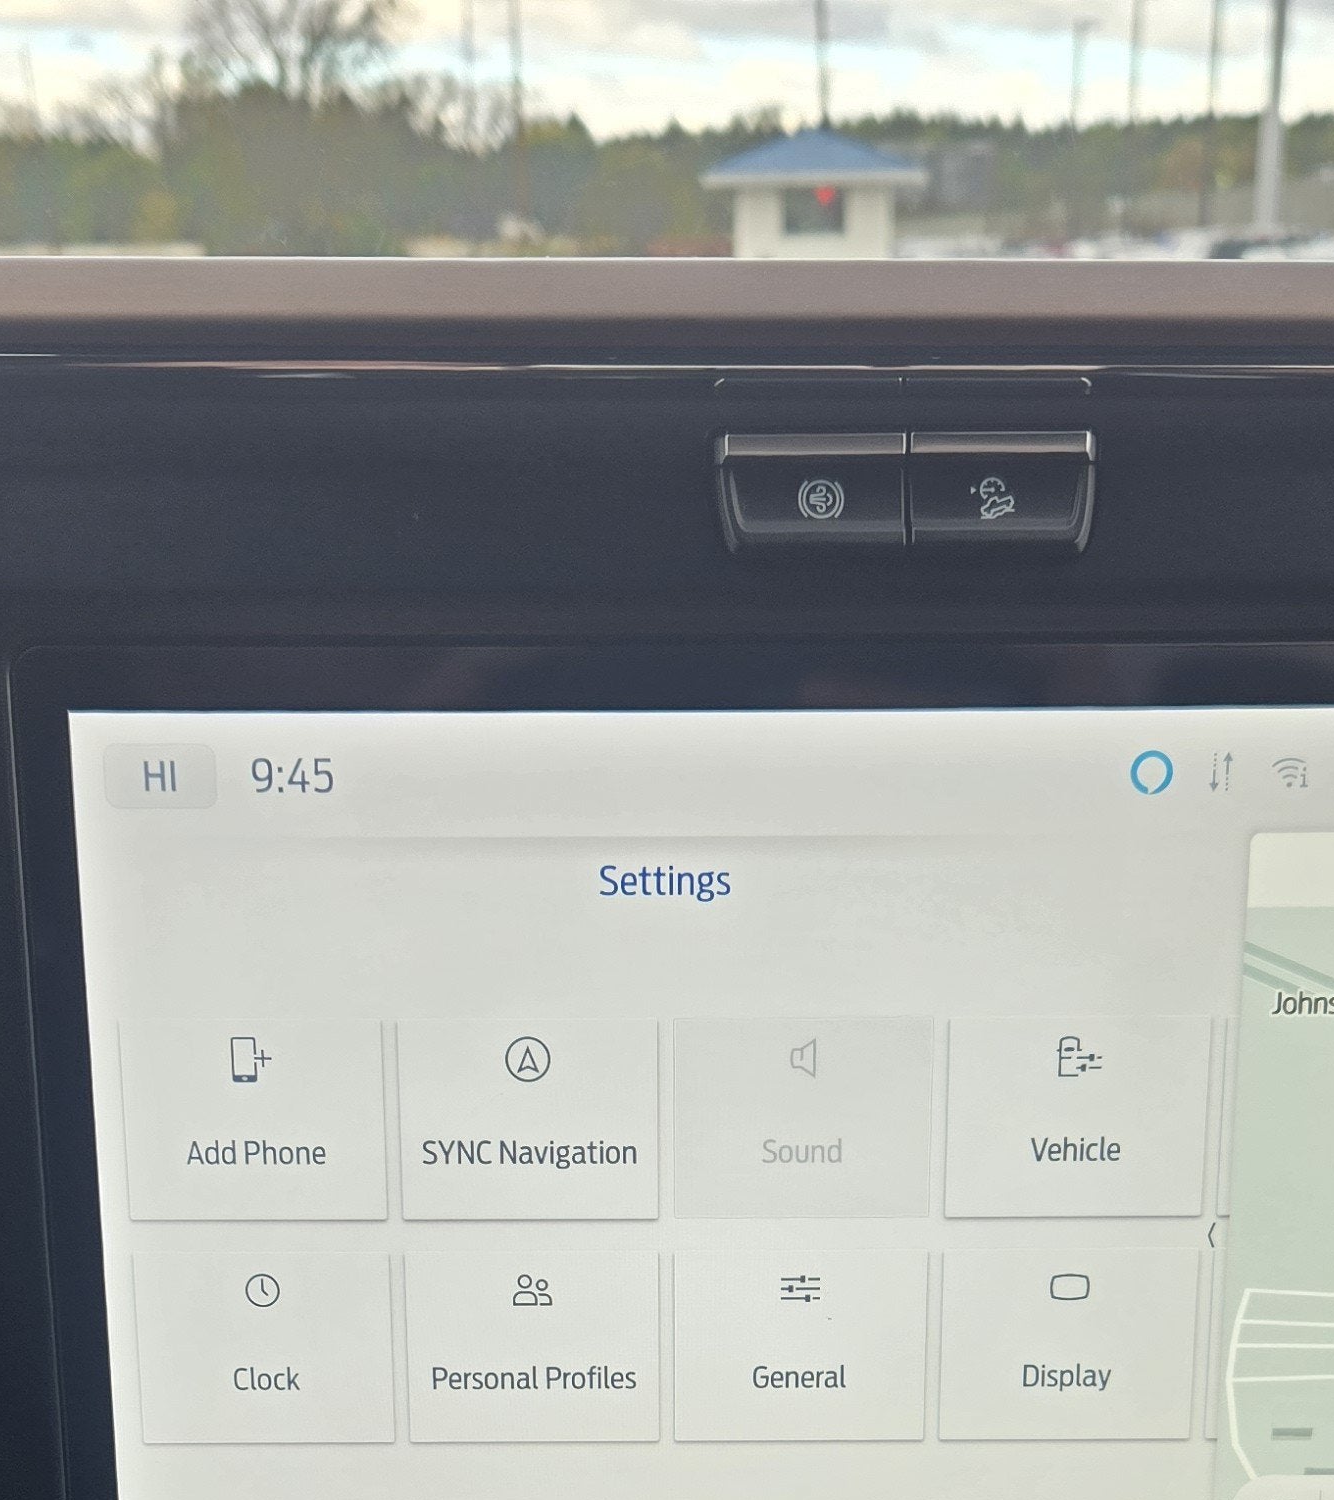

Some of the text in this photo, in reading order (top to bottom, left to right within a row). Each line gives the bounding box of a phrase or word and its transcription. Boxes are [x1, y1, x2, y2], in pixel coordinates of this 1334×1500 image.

[144, 761, 176, 792] HI
[252, 758, 333, 793] 9:45
[600, 865, 730, 902] Settings
[187, 1140, 326, 1165] Add Phone
[423, 1140, 637, 1169] SYNC Navigation
[762, 1138, 842, 1163] Sound
[1031, 1136, 1121, 1162] Vehicle
[234, 1367, 300, 1391] Clock
[432, 1366, 636, 1390] Personal Profiles
[753, 1365, 846, 1388] General
[1023, 1363, 1111, 1391] Display
